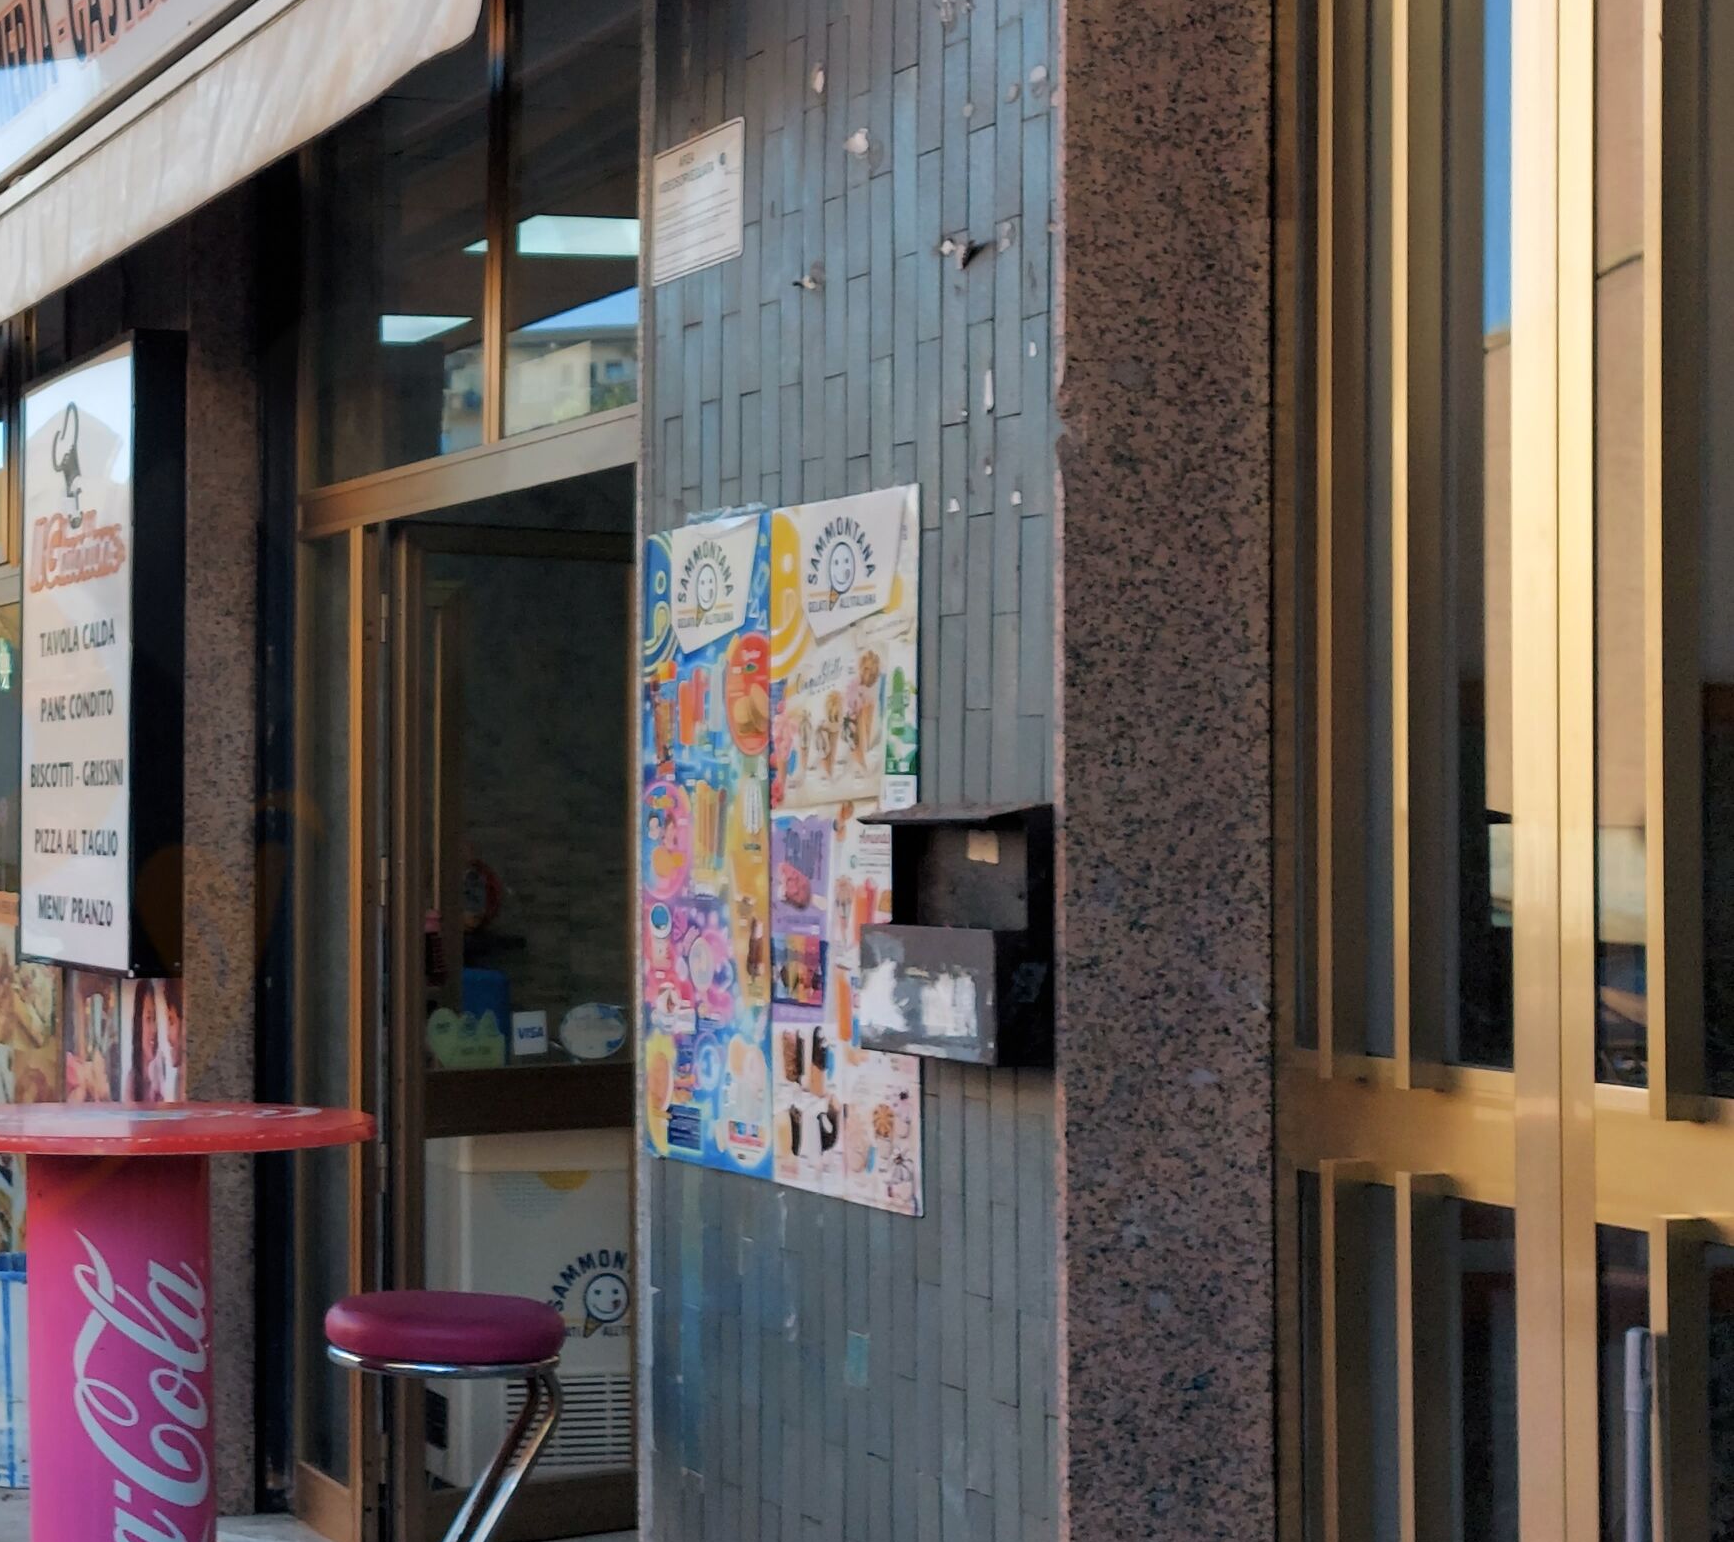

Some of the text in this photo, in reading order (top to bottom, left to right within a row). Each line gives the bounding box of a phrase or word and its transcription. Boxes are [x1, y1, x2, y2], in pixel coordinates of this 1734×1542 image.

[808, 515, 877, 585] SAMMONTANA
[677, 540, 734, 604] SAMMONTANA
[39, 617, 116, 658] TAVOLA CALDA
[40, 688, 114, 723] PANE CONDITO
[30, 761, 74, 788] BISCOTTI
[82, 758, 124, 787] GRISSINI
[34, 828, 119, 857] PIZZA AL TAGLIO
[70, 897, 114, 927] PRANZO
[517, 1025, 545, 1040] VISA
[547, 1248, 629, 1312] SAMMON
